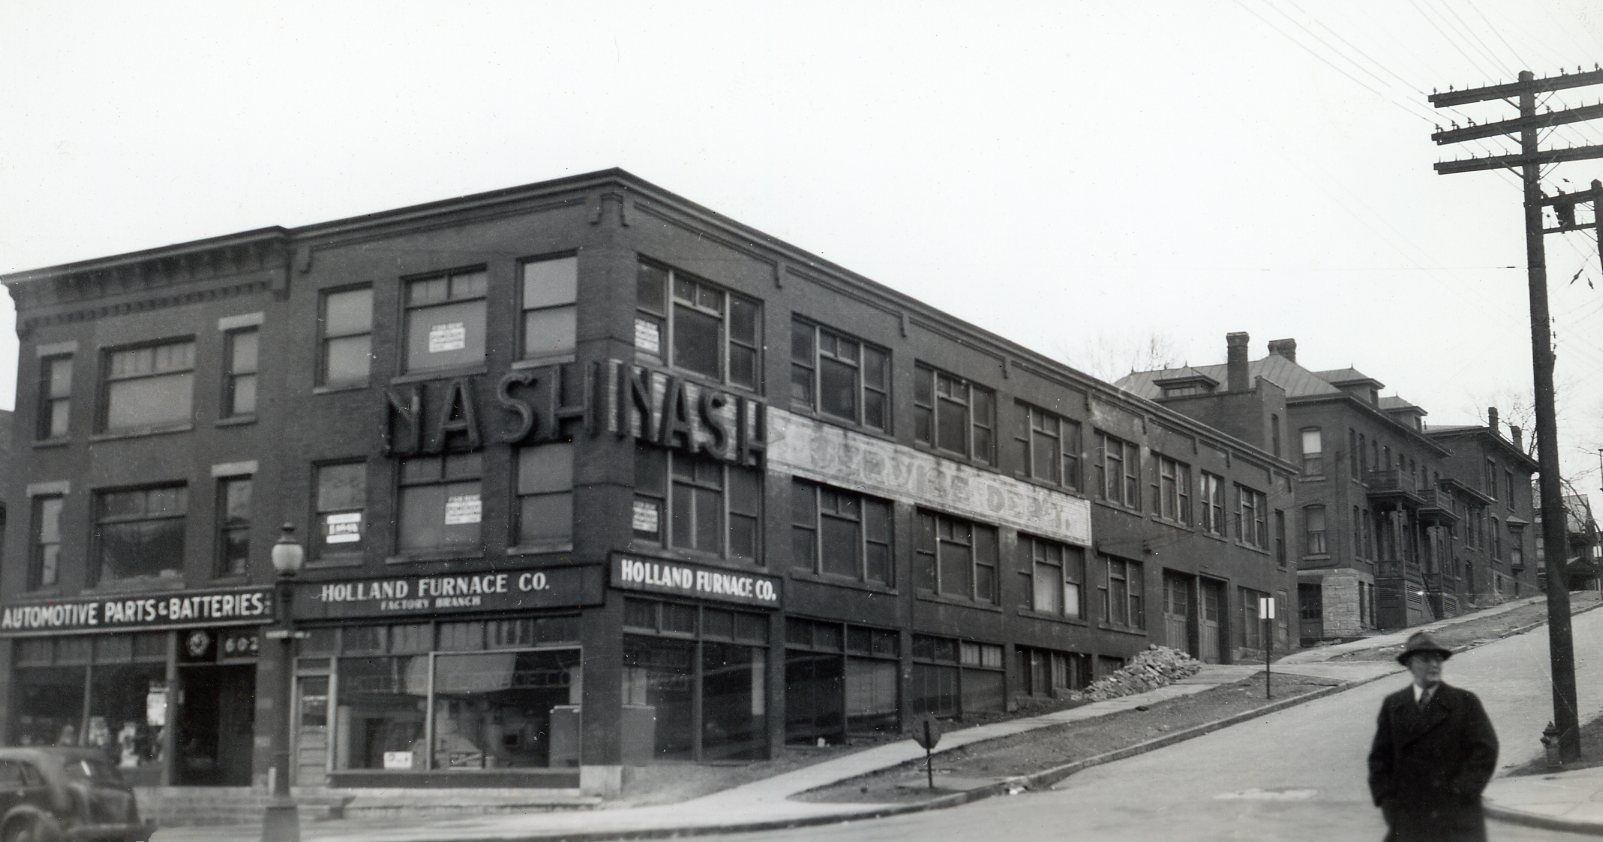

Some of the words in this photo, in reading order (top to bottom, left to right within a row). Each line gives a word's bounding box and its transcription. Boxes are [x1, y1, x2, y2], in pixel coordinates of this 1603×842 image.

[384, 362, 596, 455] NASH
[616, 362, 768, 467] NASH
[321, 581, 409, 602] HOLLAND
[418, 574, 509, 598] FURNACE
[518, 572, 550, 592] CO.
[621, 559, 693, 589] HOLLAND
[696, 570, 754, 598] FURNACE
[755, 579, 777, 601] CO.
[2, 603, 98, 628] AUTOMOTIVE
[105, 600, 157, 623] PARTS
[168, 592, 263, 620] BATTERIES
[380, 600, 430, 611] FACTORY
[435, 596, 482, 609] BRANCH
[225, 637, 258, 653] 602
